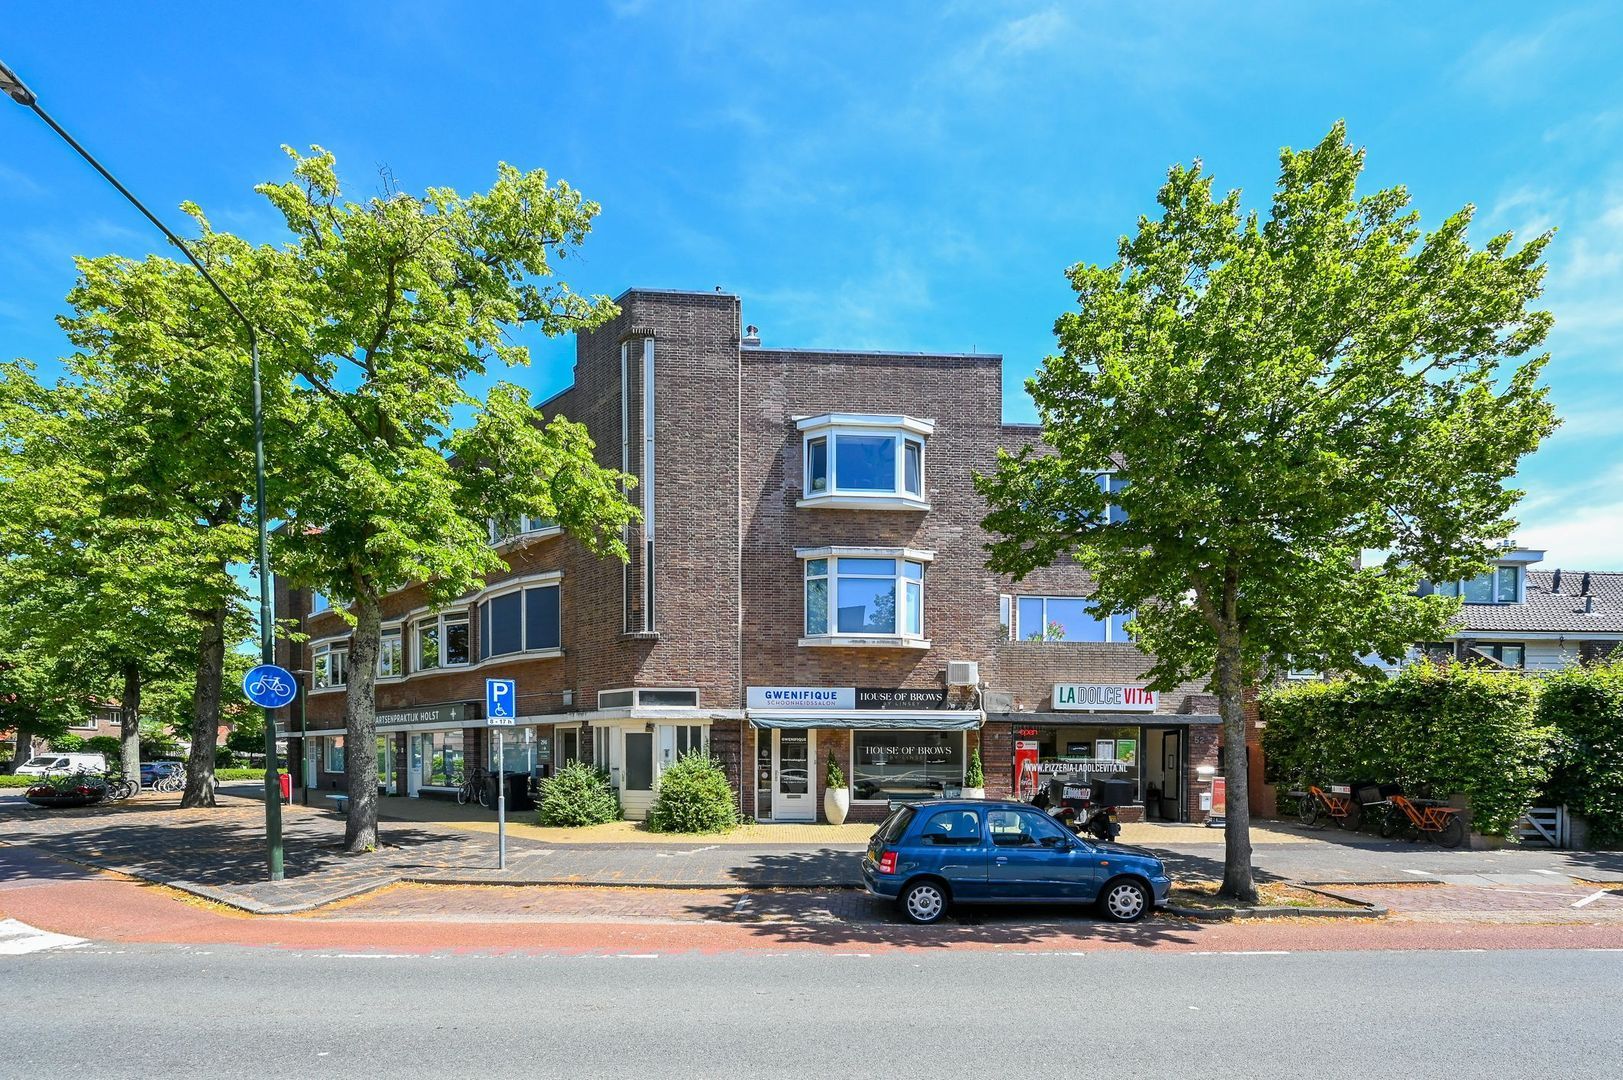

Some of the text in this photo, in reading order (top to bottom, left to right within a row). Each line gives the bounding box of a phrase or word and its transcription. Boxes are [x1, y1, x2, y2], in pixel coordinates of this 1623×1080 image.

[493, 682, 509, 702] P
[765, 690, 837, 700] GWENIFIQUE
[860, 692, 943, 701] HOUSE OF BROWS
[1060, 687, 1153, 704] LA DOLCE VITA
[420, 710, 439, 721] HOLST
[1019, 729, 1038, 737] open
[866, 746, 952, 755] HOUSE OF BROWS
